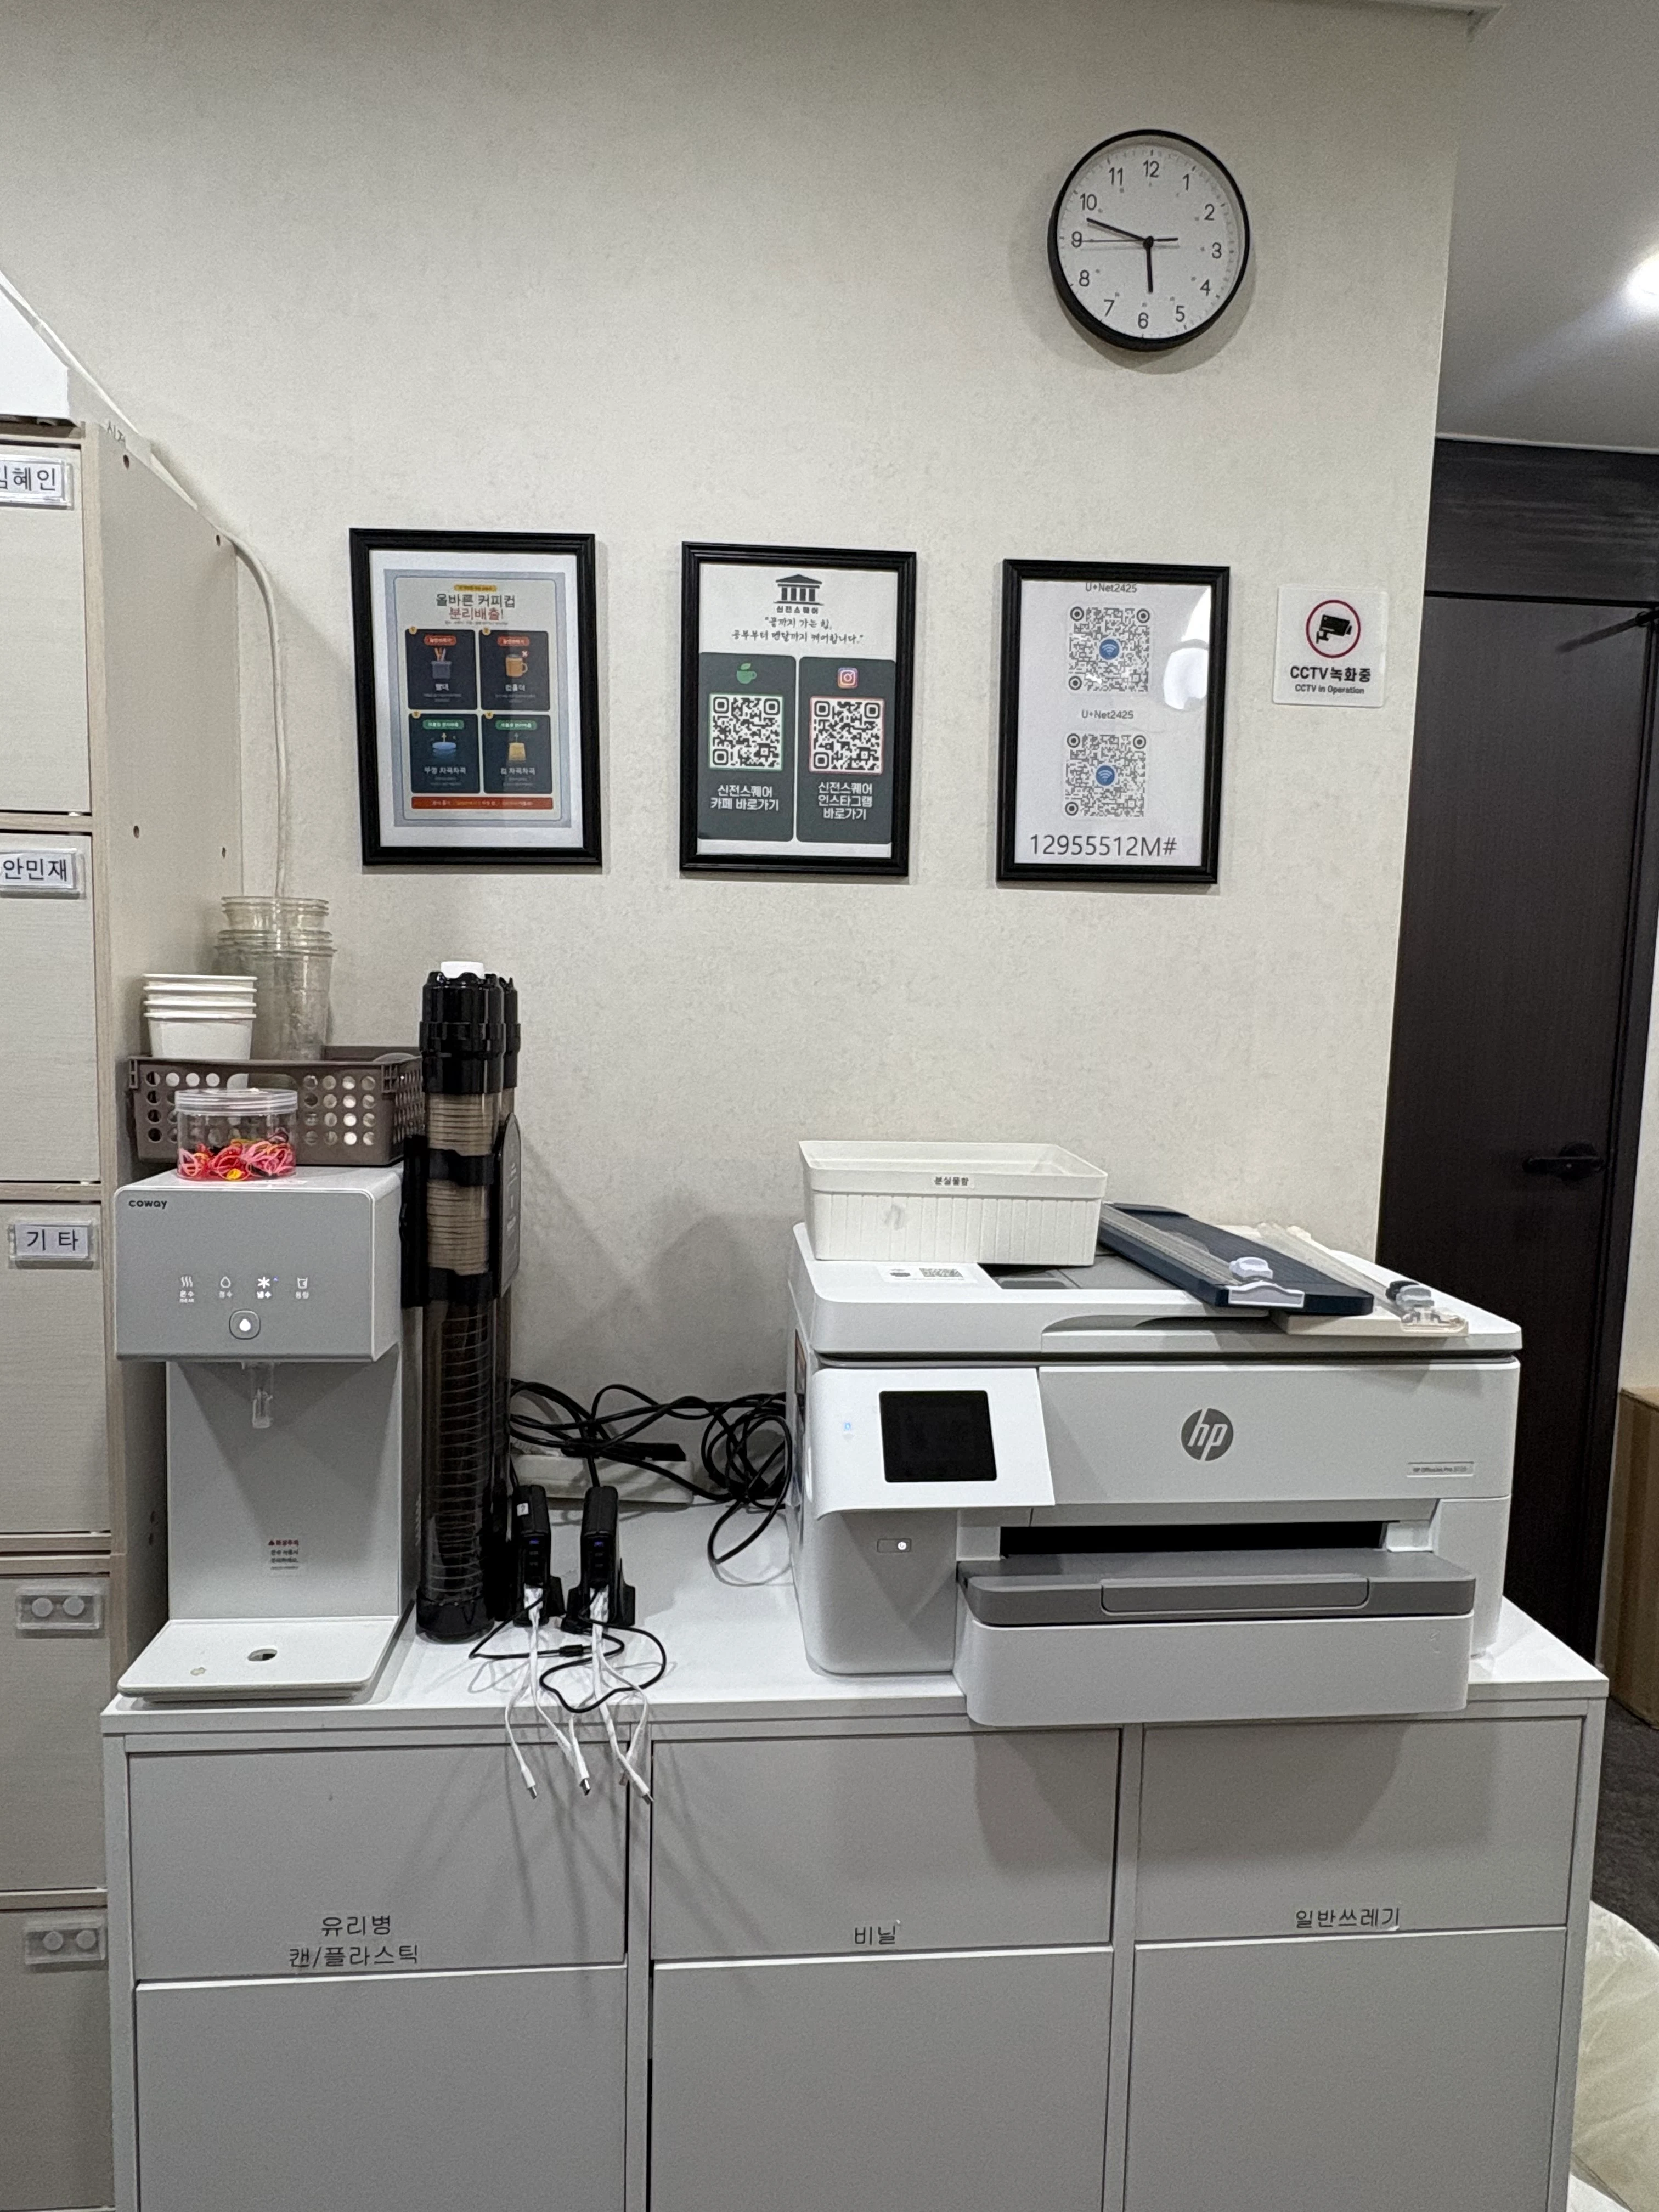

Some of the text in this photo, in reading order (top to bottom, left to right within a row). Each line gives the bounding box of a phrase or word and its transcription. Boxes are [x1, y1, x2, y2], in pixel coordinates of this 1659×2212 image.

[1108, 167, 1123, 185] 11
[1143, 160, 1159, 177] 12
[1182, 173, 1189, 190] 1
[1080, 194, 1097, 210] 10
[1204, 204, 1215, 221] 2
[1071, 232, 1082, 247] 9
[1211, 242, 1222, 259] 3
[1079, 270, 1090, 286] 8
[1200, 279, 1211, 296] 4
[1104, 299, 1115, 316] 7
[1175, 306, 1185, 322] 5
[1138, 312, 1148, 329] 6
[1086, 582, 1137, 593] U+Net2425
[436, 594, 515, 608] 올바른 커피컵
[799, 618, 817, 628] 가는
[732, 630, 768, 640] 공부부터
[772, 631, 808, 642] 멘탈까지
[1295, 684, 1316, 692] CCTV
[1328, 685, 1365, 695] Operation
[1082, 710, 1133, 720] U+Net2425
[717, 785, 772, 798] 신전스퀘어
[818, 782, 872, 795] 신전스퀘어
[710, 798, 779, 811] 카페 바로가기
[818, 796, 872, 808] 인스타그램
[823, 808, 866, 820] 바로가기
[1030, 834, 1177, 856] 12955512M#
[3, 857, 67, 882] 안민재
[1187, 1407, 1228, 1461] hp
[321, 1915, 391, 1937] 유리병
[1296, 1907, 1399, 1929] 일반쓰레기
[855, 1925, 895, 1945] 비닐
[289, 1944, 418, 1968] 캔/플라스틱
